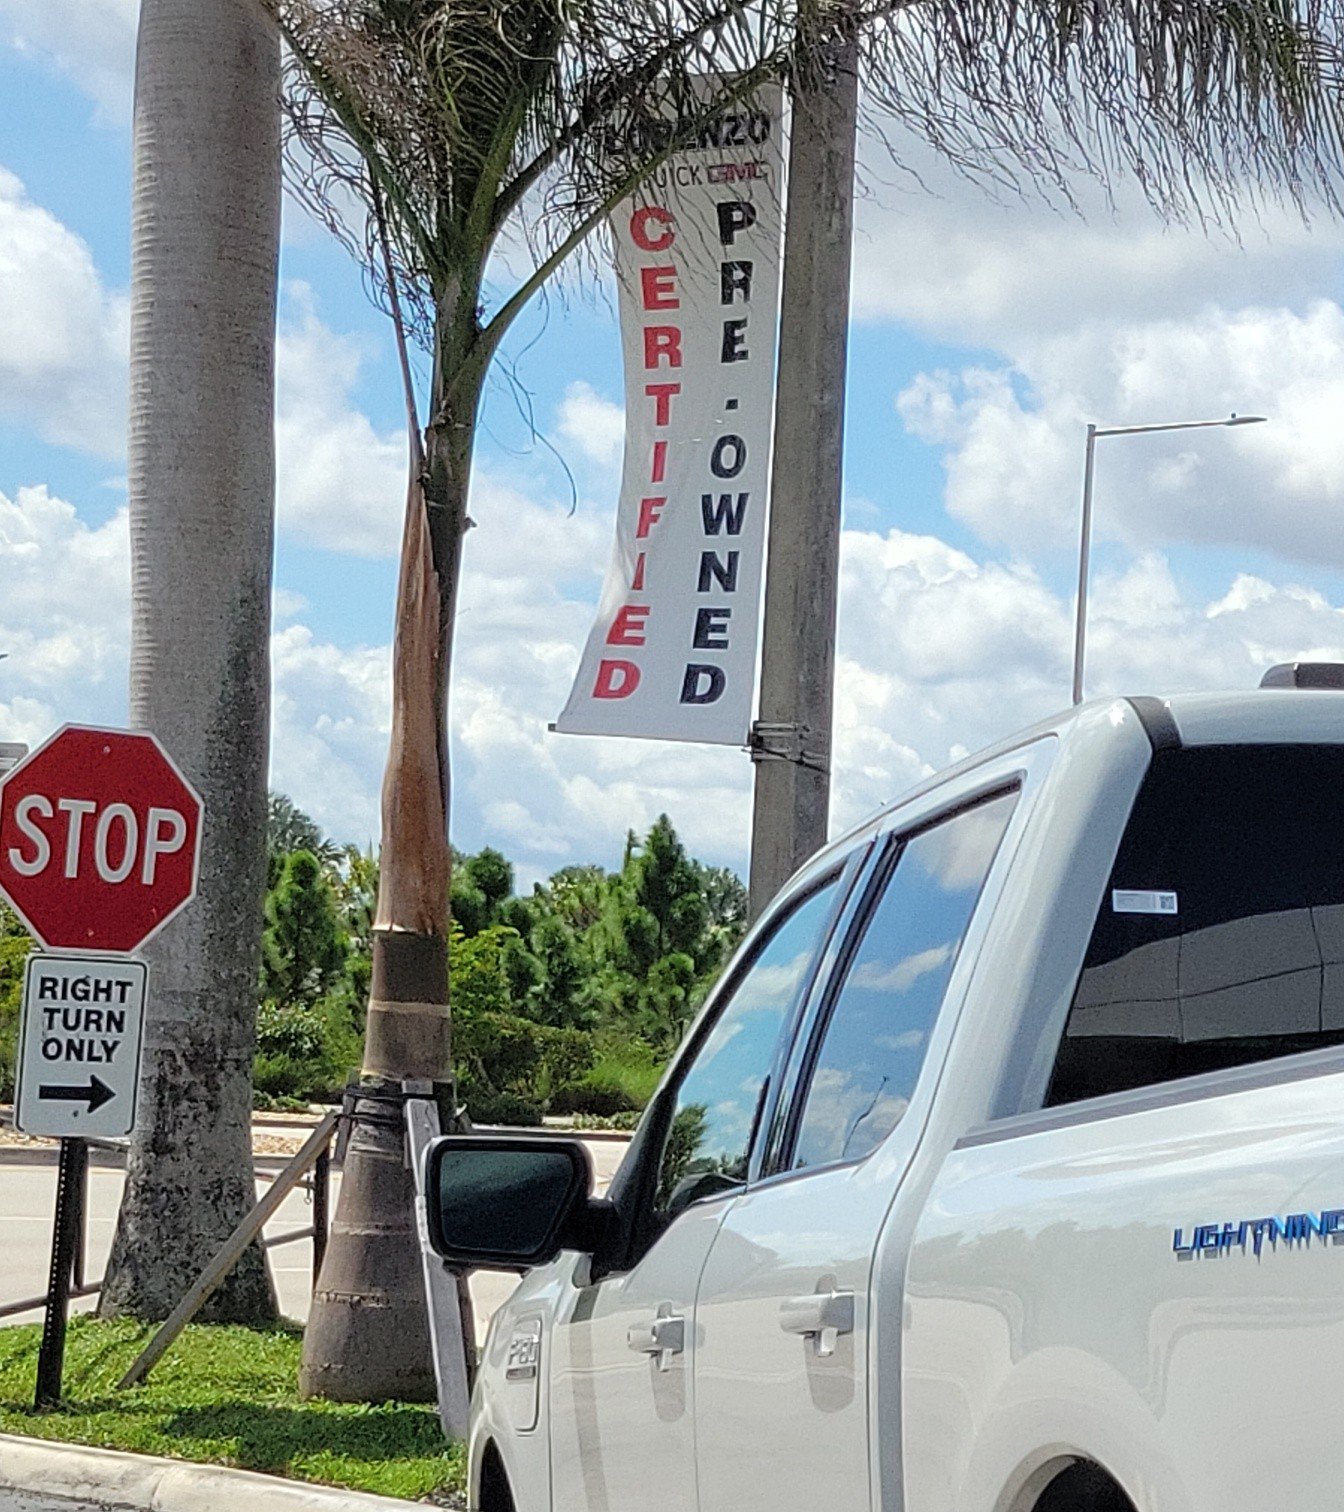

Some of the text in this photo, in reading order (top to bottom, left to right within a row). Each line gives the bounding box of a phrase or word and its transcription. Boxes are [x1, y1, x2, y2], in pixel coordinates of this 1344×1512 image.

[592, 205, 682, 700] CERTIFIED
[8, 794, 187, 885] STOP
[38, 976, 134, 1005] RIGHT
[43, 1007, 126, 1034] TURN
[41, 1037, 121, 1063] ONLY
